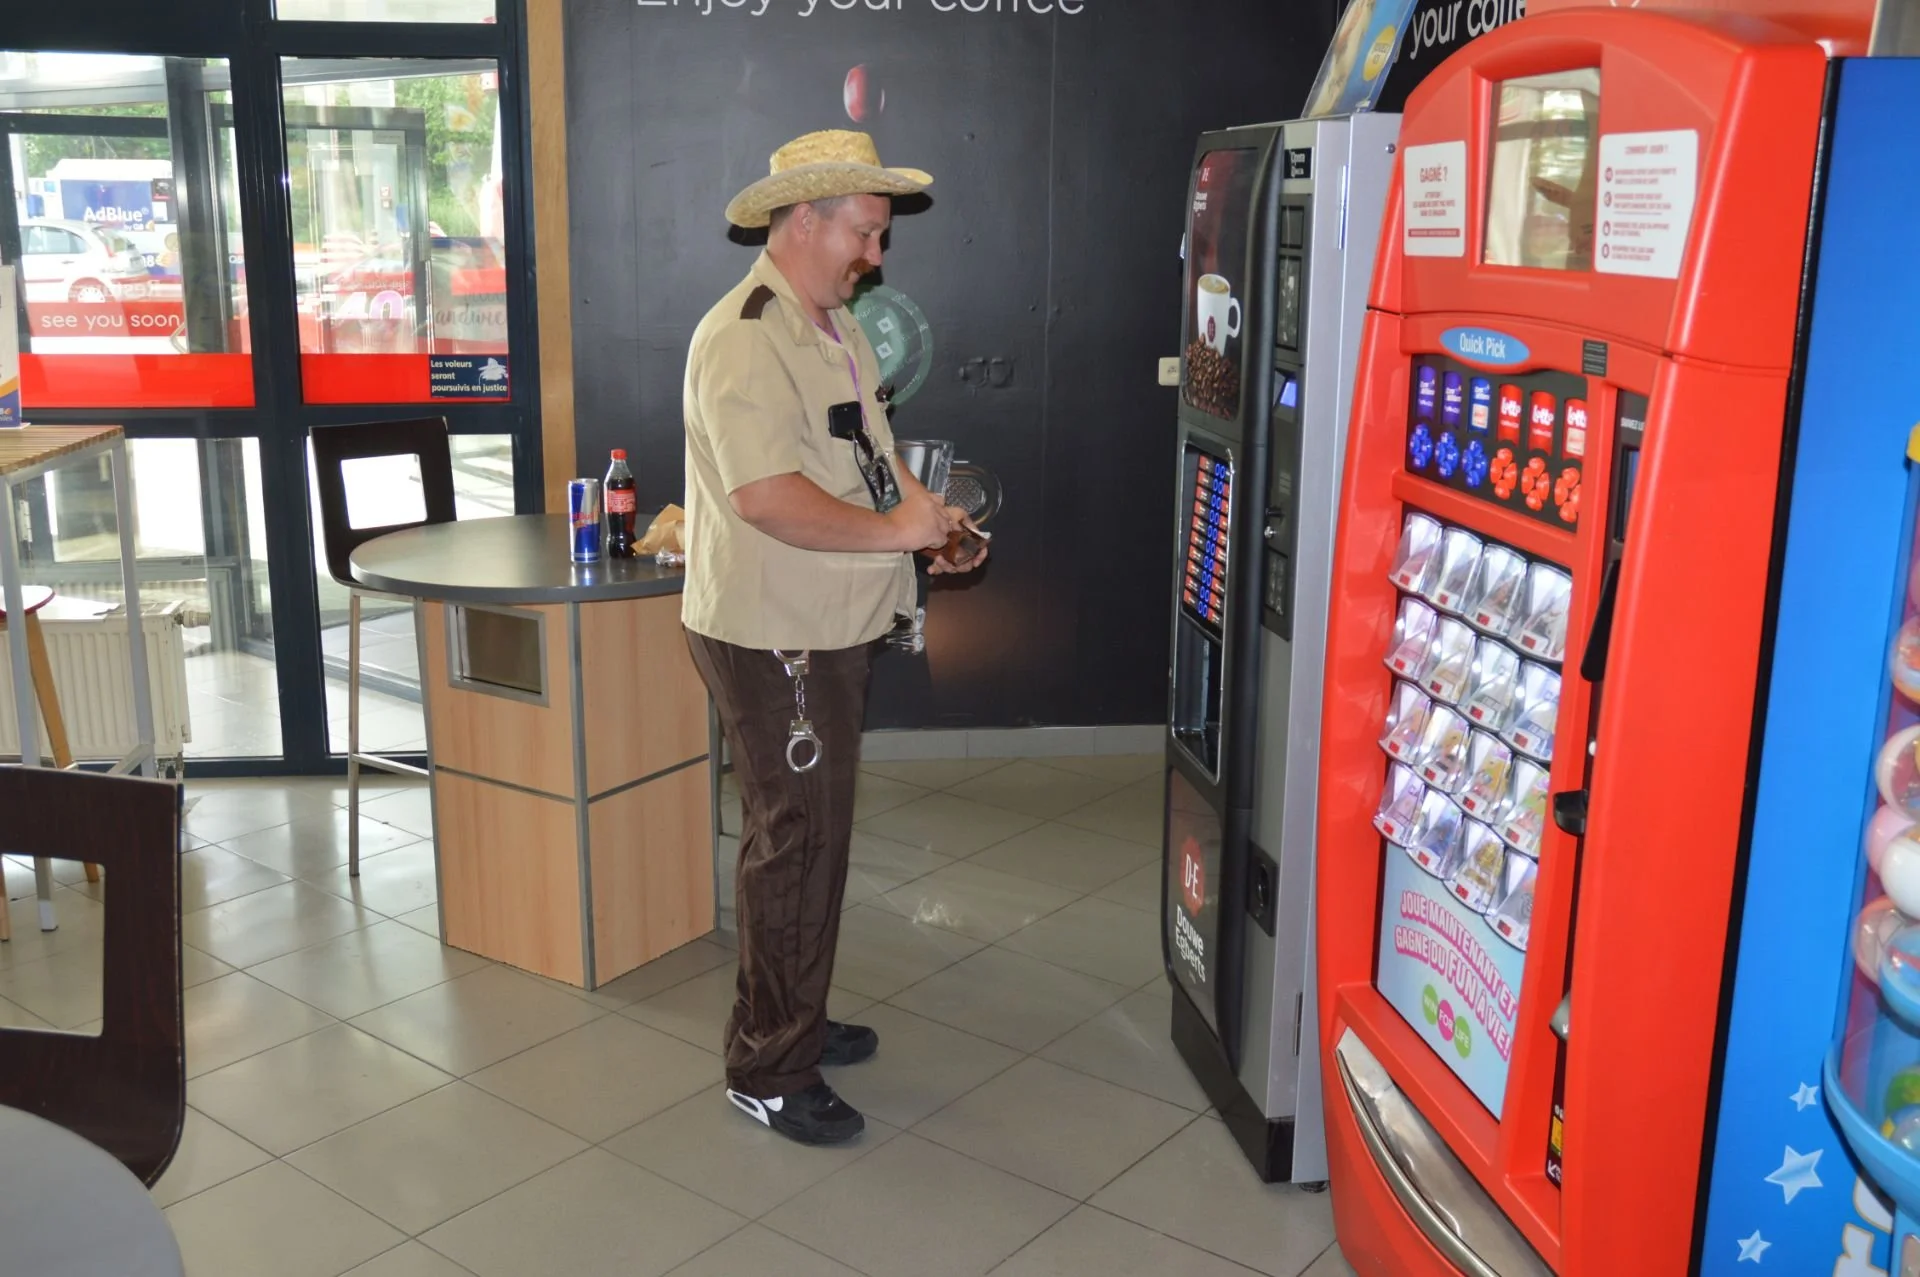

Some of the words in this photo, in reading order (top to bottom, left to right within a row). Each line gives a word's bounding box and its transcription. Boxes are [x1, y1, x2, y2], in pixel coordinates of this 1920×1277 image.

[1410, 1, 1462, 60] your
[41, 314, 77, 327] see
[84, 314, 123, 332] you
[130, 314, 180, 327] soon
[1460, 332, 1484, 355] Quick
[1486, 337, 1506, 360] Pick
[431, 360, 443, 368] Les
[445, 360, 472, 368] voleurs
[431, 372, 455, 380] seront
[432, 384, 470, 393] poursuivis
[483, 384, 508, 393] justice
[1177, 903, 1204, 957] Douwe
[1175, 925, 1206, 983] Egberts
[1401, 891, 1427, 920] JOUE
[1428, 902, 1498, 995] MAINTENANT
[1500, 982, 1517, 1018] ET
[1396, 927, 1429, 961] GAGNE
[1430, 942, 1446, 972] DU
[1447, 950, 1476, 1006] FUN
[1476, 988, 1486, 1021] À
[1439, 1008, 1453, 1032] FOR
[1455, 1026, 1470, 1049] LIFE
